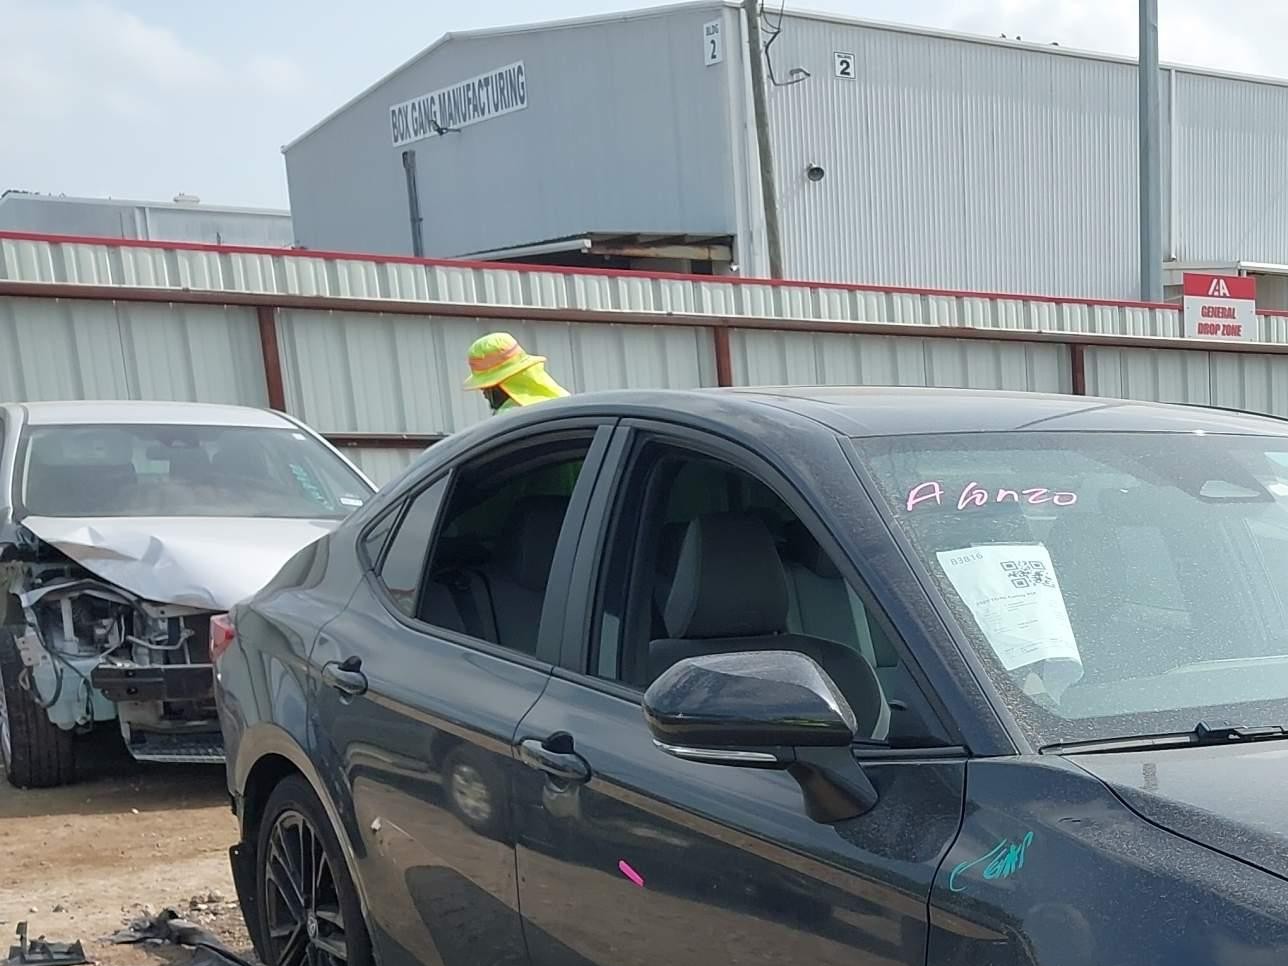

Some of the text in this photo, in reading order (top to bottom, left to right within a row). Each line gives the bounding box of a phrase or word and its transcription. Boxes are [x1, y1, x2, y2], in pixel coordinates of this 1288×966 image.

[710, 39, 717, 59] 2
[839, 59, 850, 76] 2
[391, 64, 526, 143] BOX GANG MANUFACTURING
[1201, 305, 1236, 320] GENERAL
[1197, 322, 1242, 337] DROP ZONE
